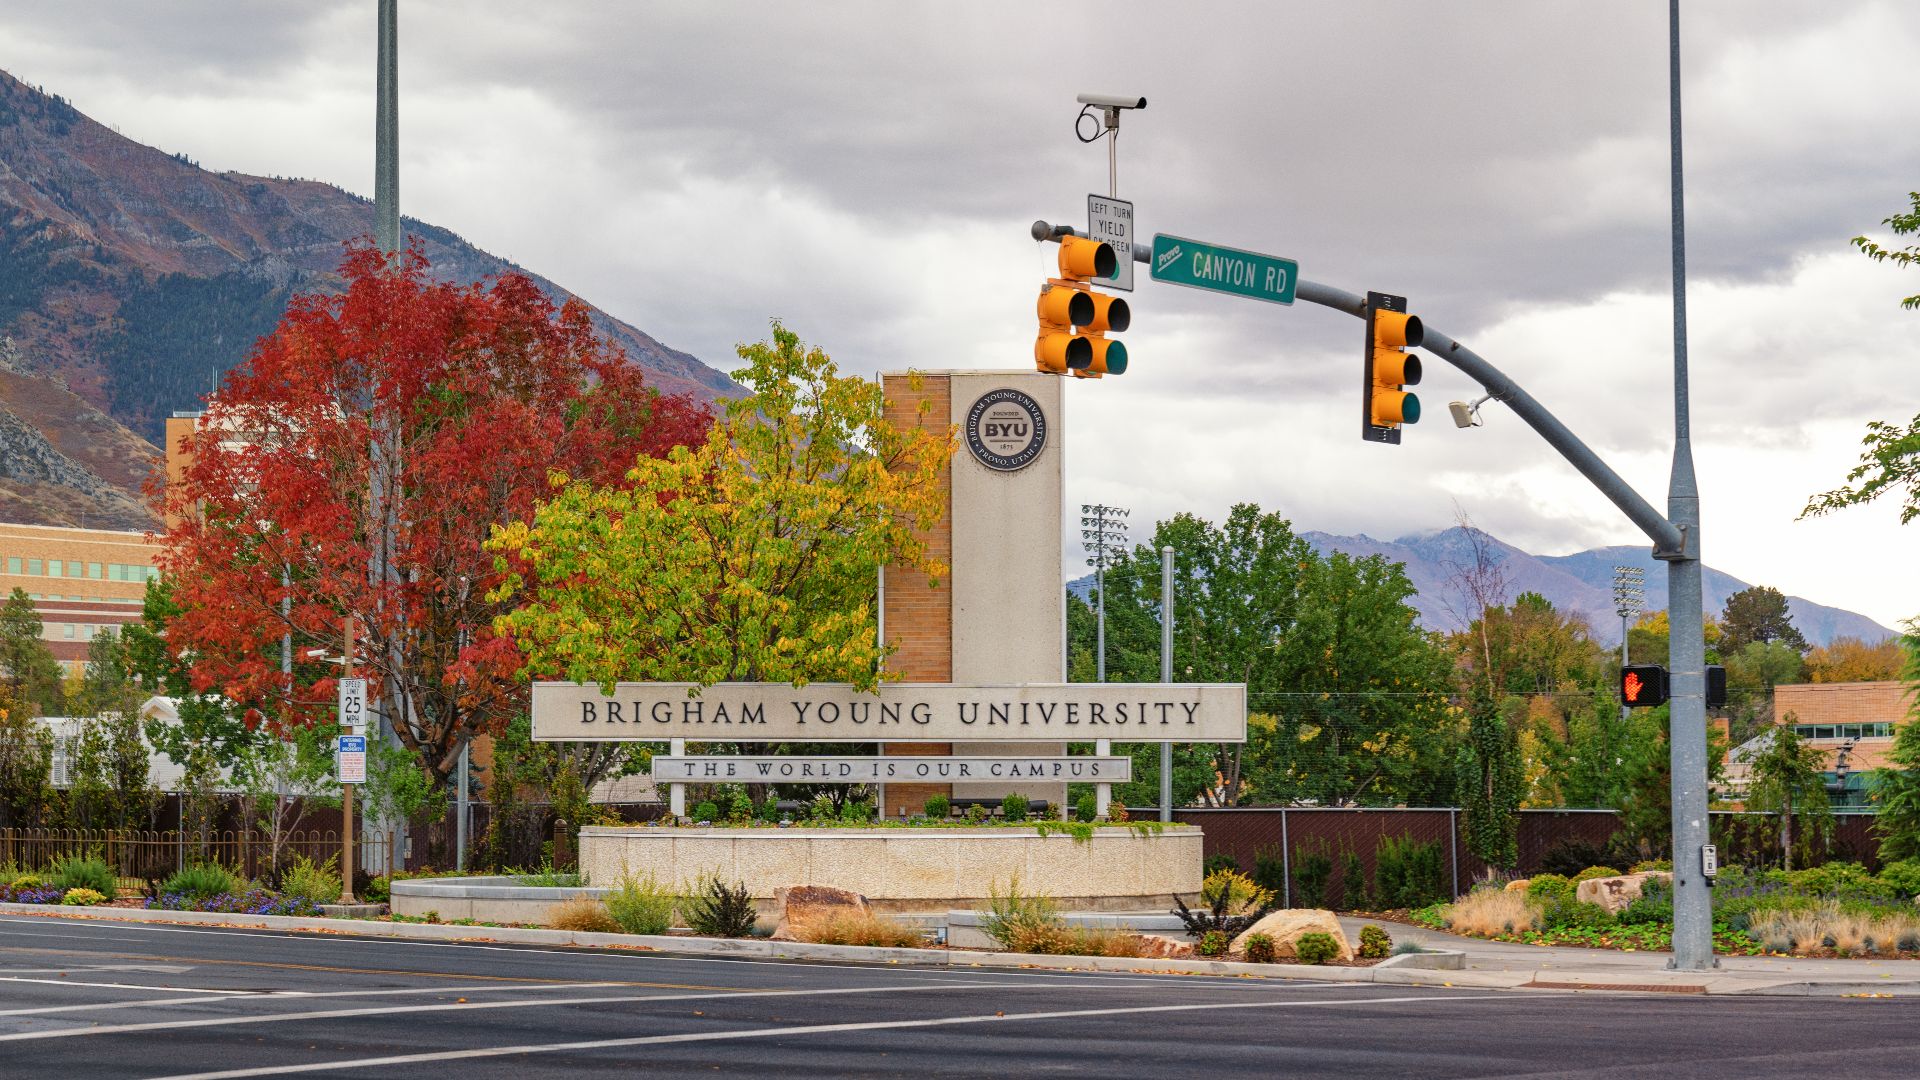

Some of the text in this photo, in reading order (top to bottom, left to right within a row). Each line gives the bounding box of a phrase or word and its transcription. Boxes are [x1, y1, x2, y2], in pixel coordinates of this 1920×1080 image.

[1090, 202, 1132, 220] LEFT TURN
[1098, 219, 1125, 237] YIELD
[1157, 244, 1181, 266] Provo
[1193, 251, 1288, 294] CANYON RD
[969, 392, 1044, 442] BRIGHAM YOUNG UNIVERSITY
[984, 423, 1028, 437] BYU
[1011, 448, 1035, 465] UTAH
[345, 680, 361, 688] SPEED
[345, 696, 361, 714] 25
[580, 701, 1201, 725] BRIGHAM YOUNG UNIVERSITY
[346, 715, 360, 724] MPH
[684, 762, 1100, 777] THE WORLD IS OUR CAMPUS
